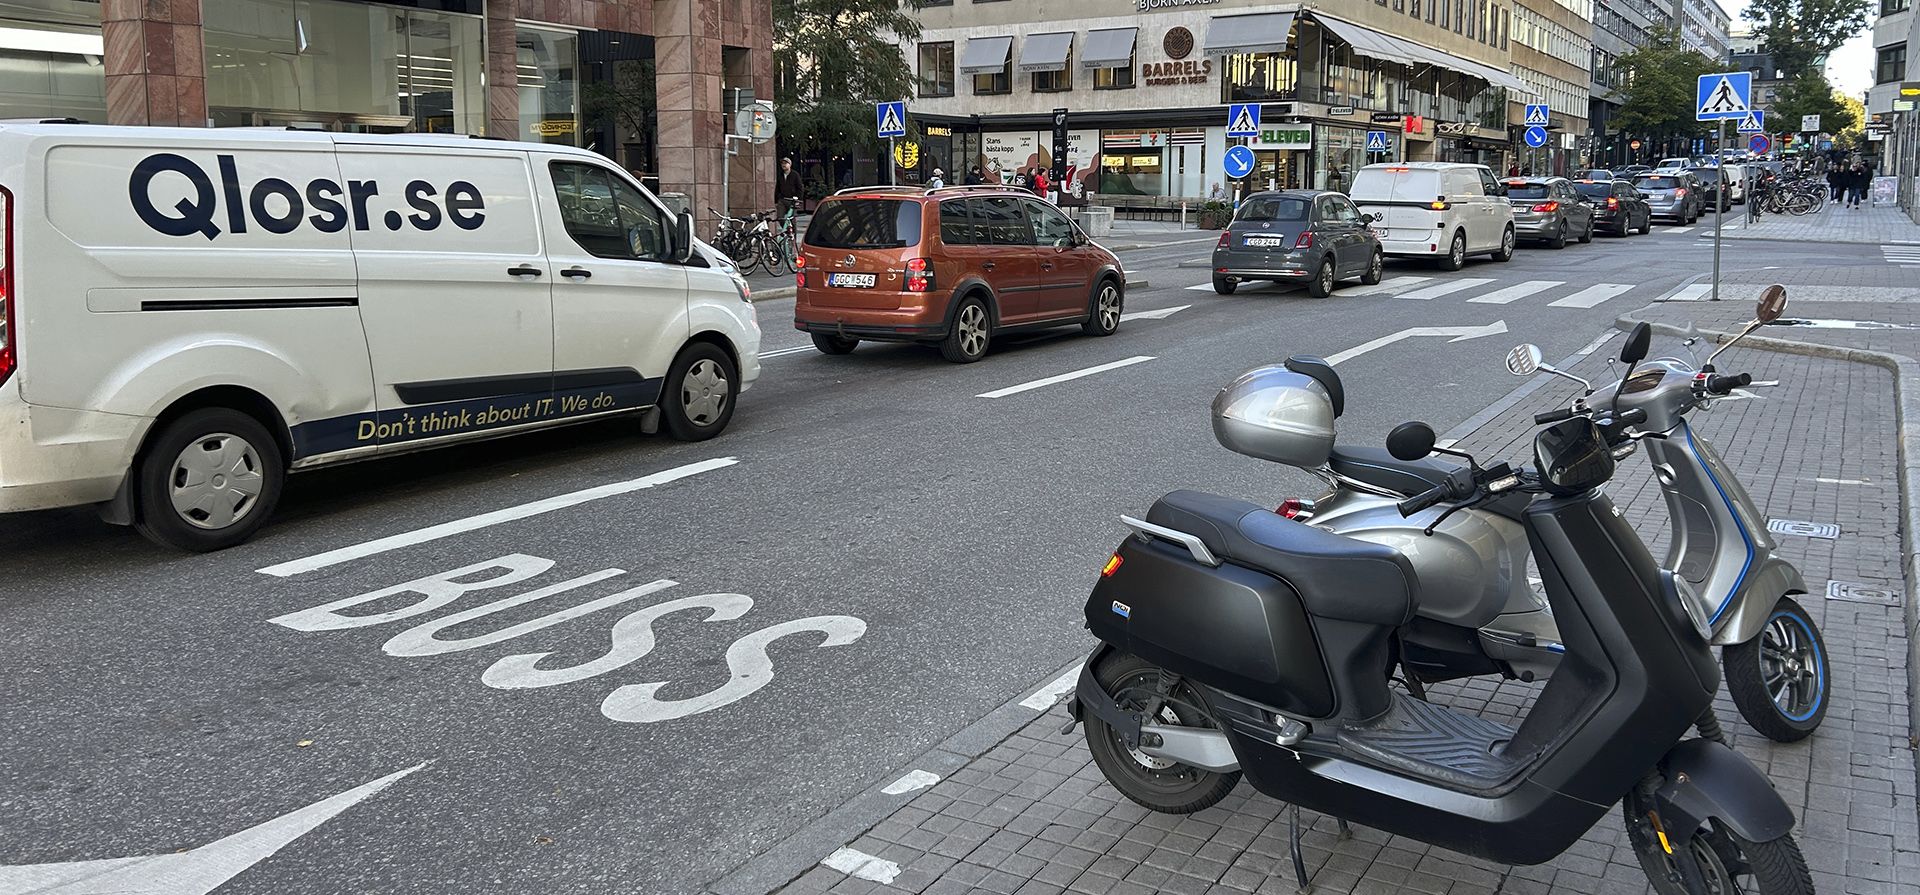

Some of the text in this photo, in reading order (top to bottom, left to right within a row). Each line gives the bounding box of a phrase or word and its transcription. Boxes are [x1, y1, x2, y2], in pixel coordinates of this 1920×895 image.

[1142, 60, 1212, 77] BARRELS
[1146, 77, 1180, 86] BURGERS
[1188, 76, 1208, 85] BEER
[927, 126, 952, 137] BARRELS
[986, 137, 1001, 145] Stans
[986, 145, 1001, 153] bästa
[1001, 145, 1014, 154] kopp
[129, 152, 487, 242] Qlosr.se
[834, 274, 873, 285] GGC 546
[420, 409, 471, 432] think
[475, 403, 531, 425] about
[534, 398, 555, 417] IT.
[560, 394, 588, 413] We
[591, 391, 616, 409] do.
[266, 552, 868, 723] BUSS
